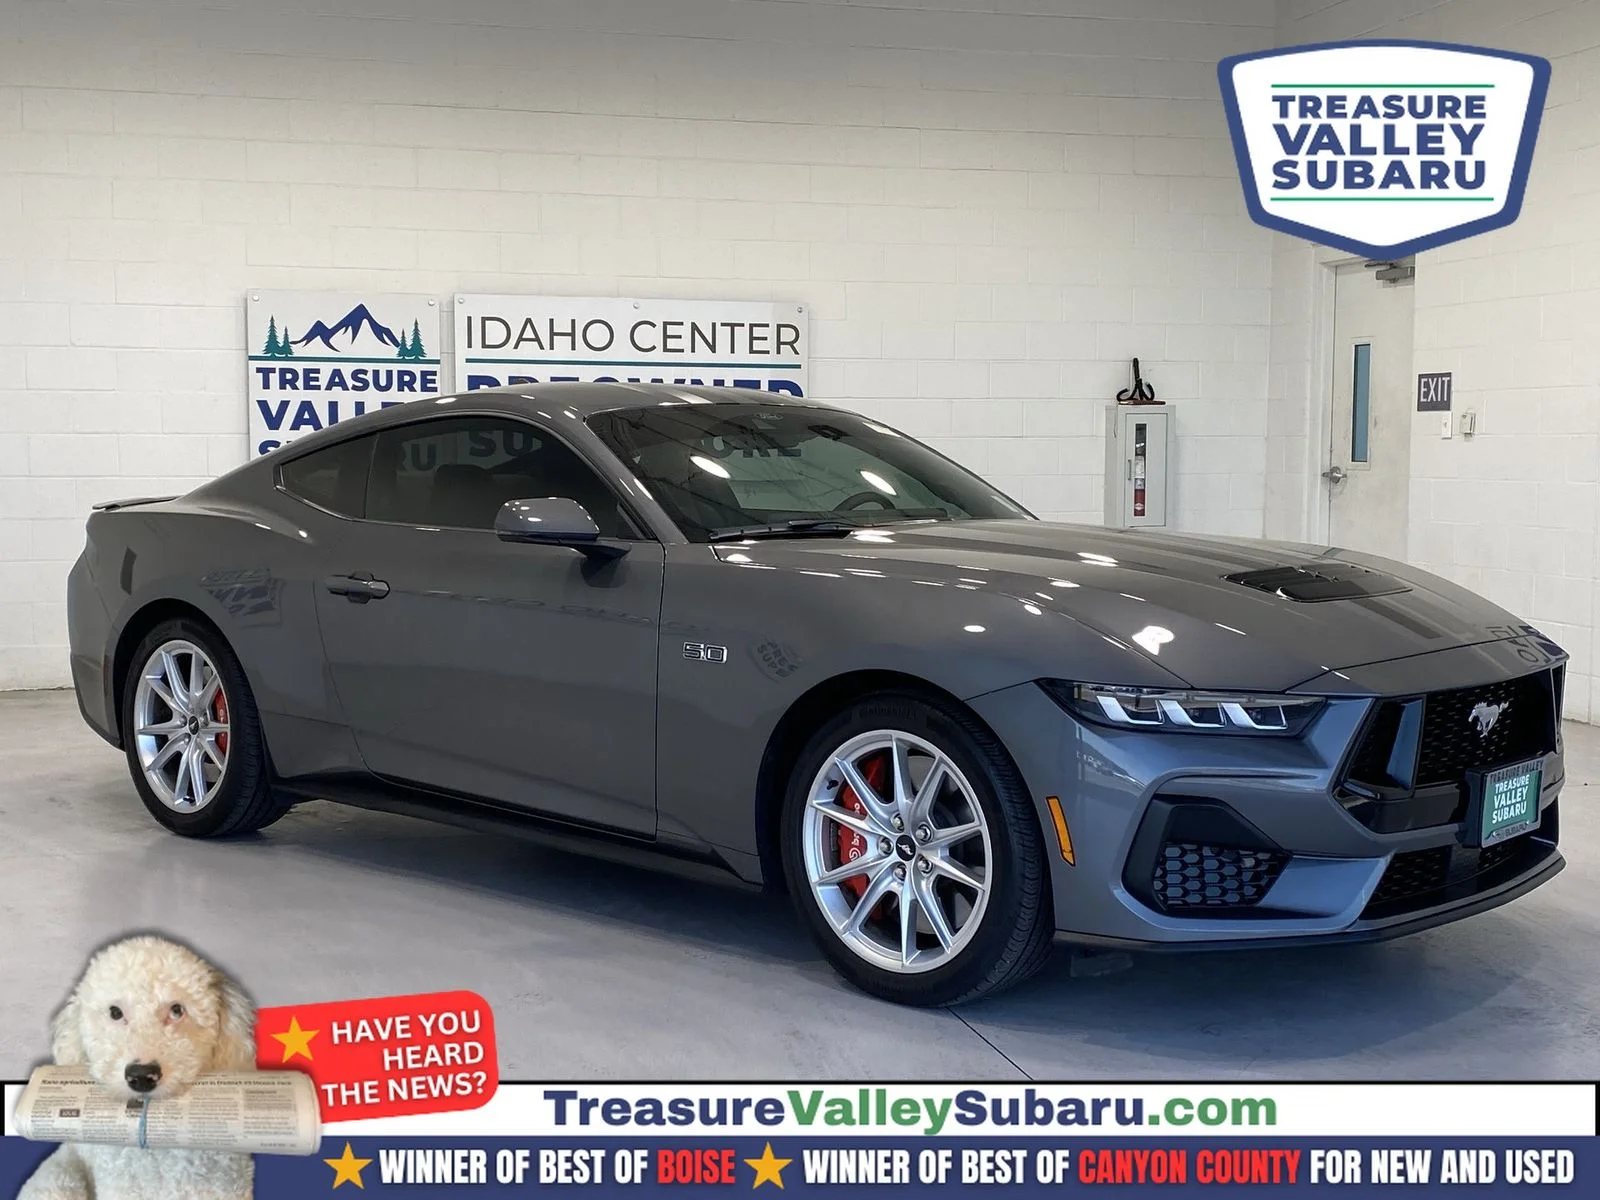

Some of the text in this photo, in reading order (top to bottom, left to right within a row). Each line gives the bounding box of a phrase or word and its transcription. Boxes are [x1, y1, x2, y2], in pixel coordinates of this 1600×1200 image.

[466, 315, 801, 356] IDAHO CENTER
[255, 367, 438, 393] TREASURE
[1420, 377, 1451, 402] EXIT
[682, 641, 729, 664] 5.0
[1495, 775, 1530, 794] TREASURE
[1493, 786, 1529, 809] VALLEY
[1492, 801, 1527, 824] SUBARU
